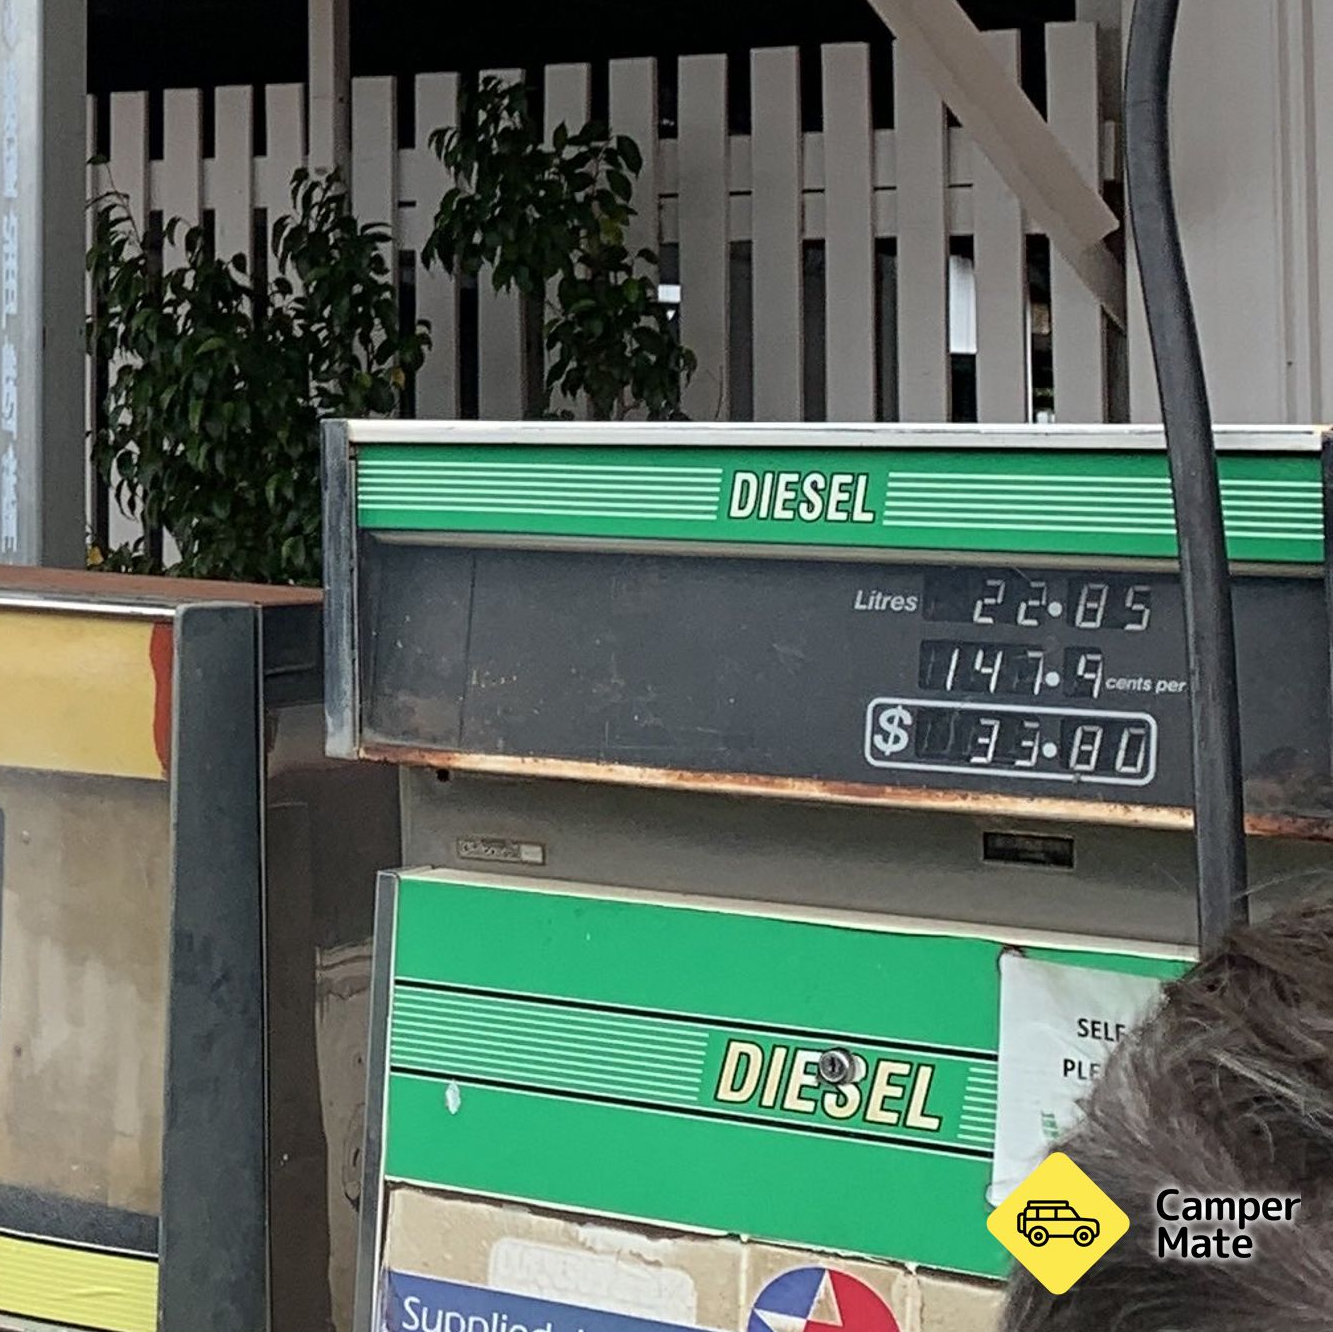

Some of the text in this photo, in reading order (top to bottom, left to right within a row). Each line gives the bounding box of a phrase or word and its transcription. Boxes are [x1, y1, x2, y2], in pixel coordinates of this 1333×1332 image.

[728, 470, 876, 524] DIESEL
[854, 578, 1153, 632] Litres 22.85
[945, 646, 1187, 700] 147.9 cents per
[873, 704, 1148, 775] $ 33.80
[1076, 1018, 1126, 1042] SELF
[714, 1038, 943, 1132] DIESEL
